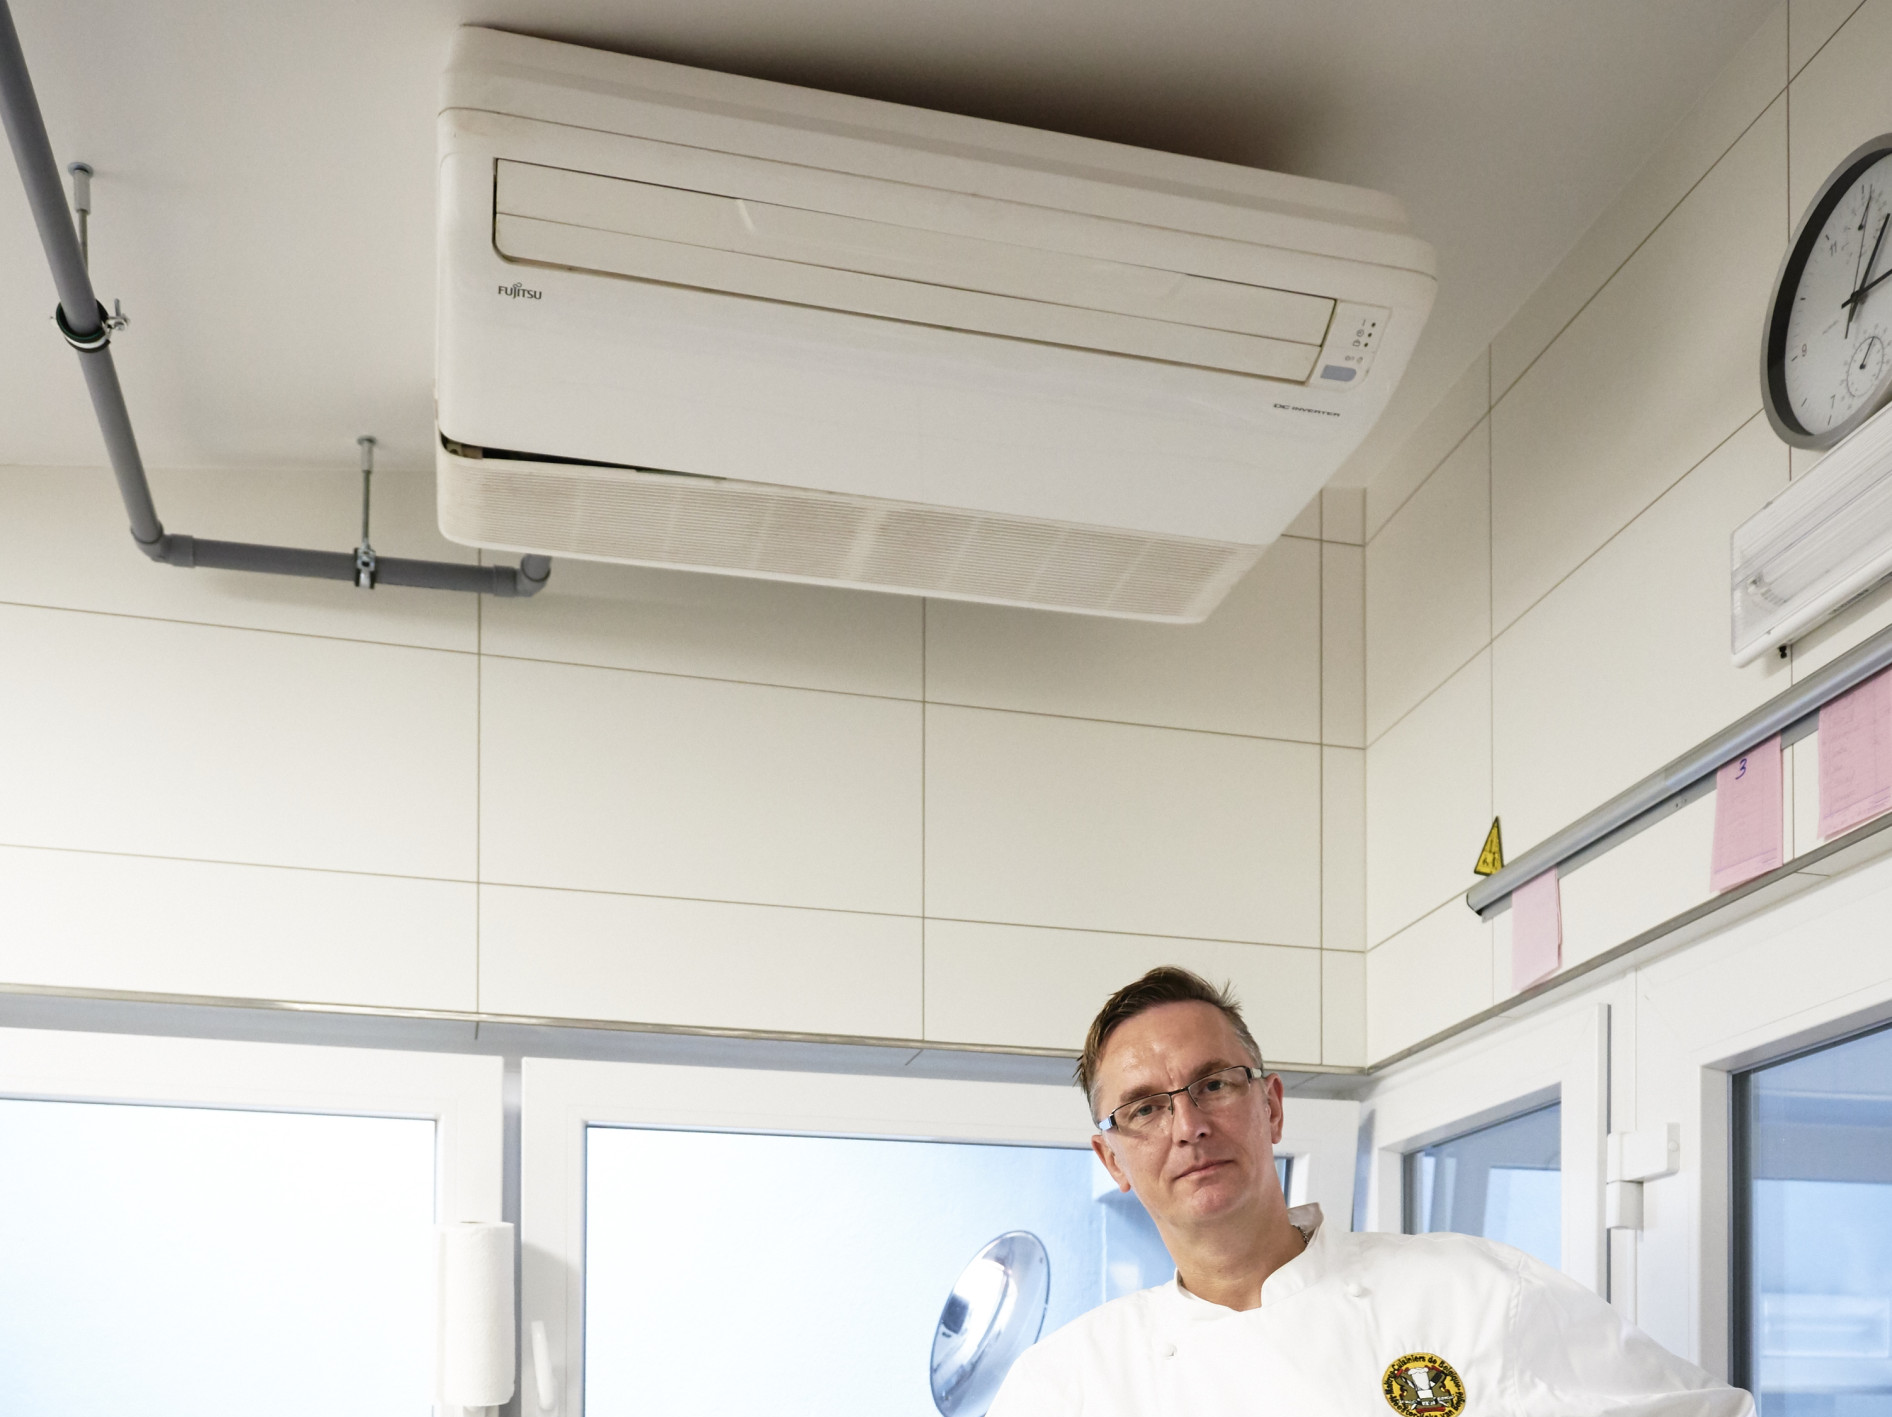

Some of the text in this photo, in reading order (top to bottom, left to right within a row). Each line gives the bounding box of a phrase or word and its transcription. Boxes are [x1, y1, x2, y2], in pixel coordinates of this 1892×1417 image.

[498, 282, 542, 300] FUJITSU
[1291, 405, 1341, 418] INVERTER
[1735, 758, 1748, 780] 3
